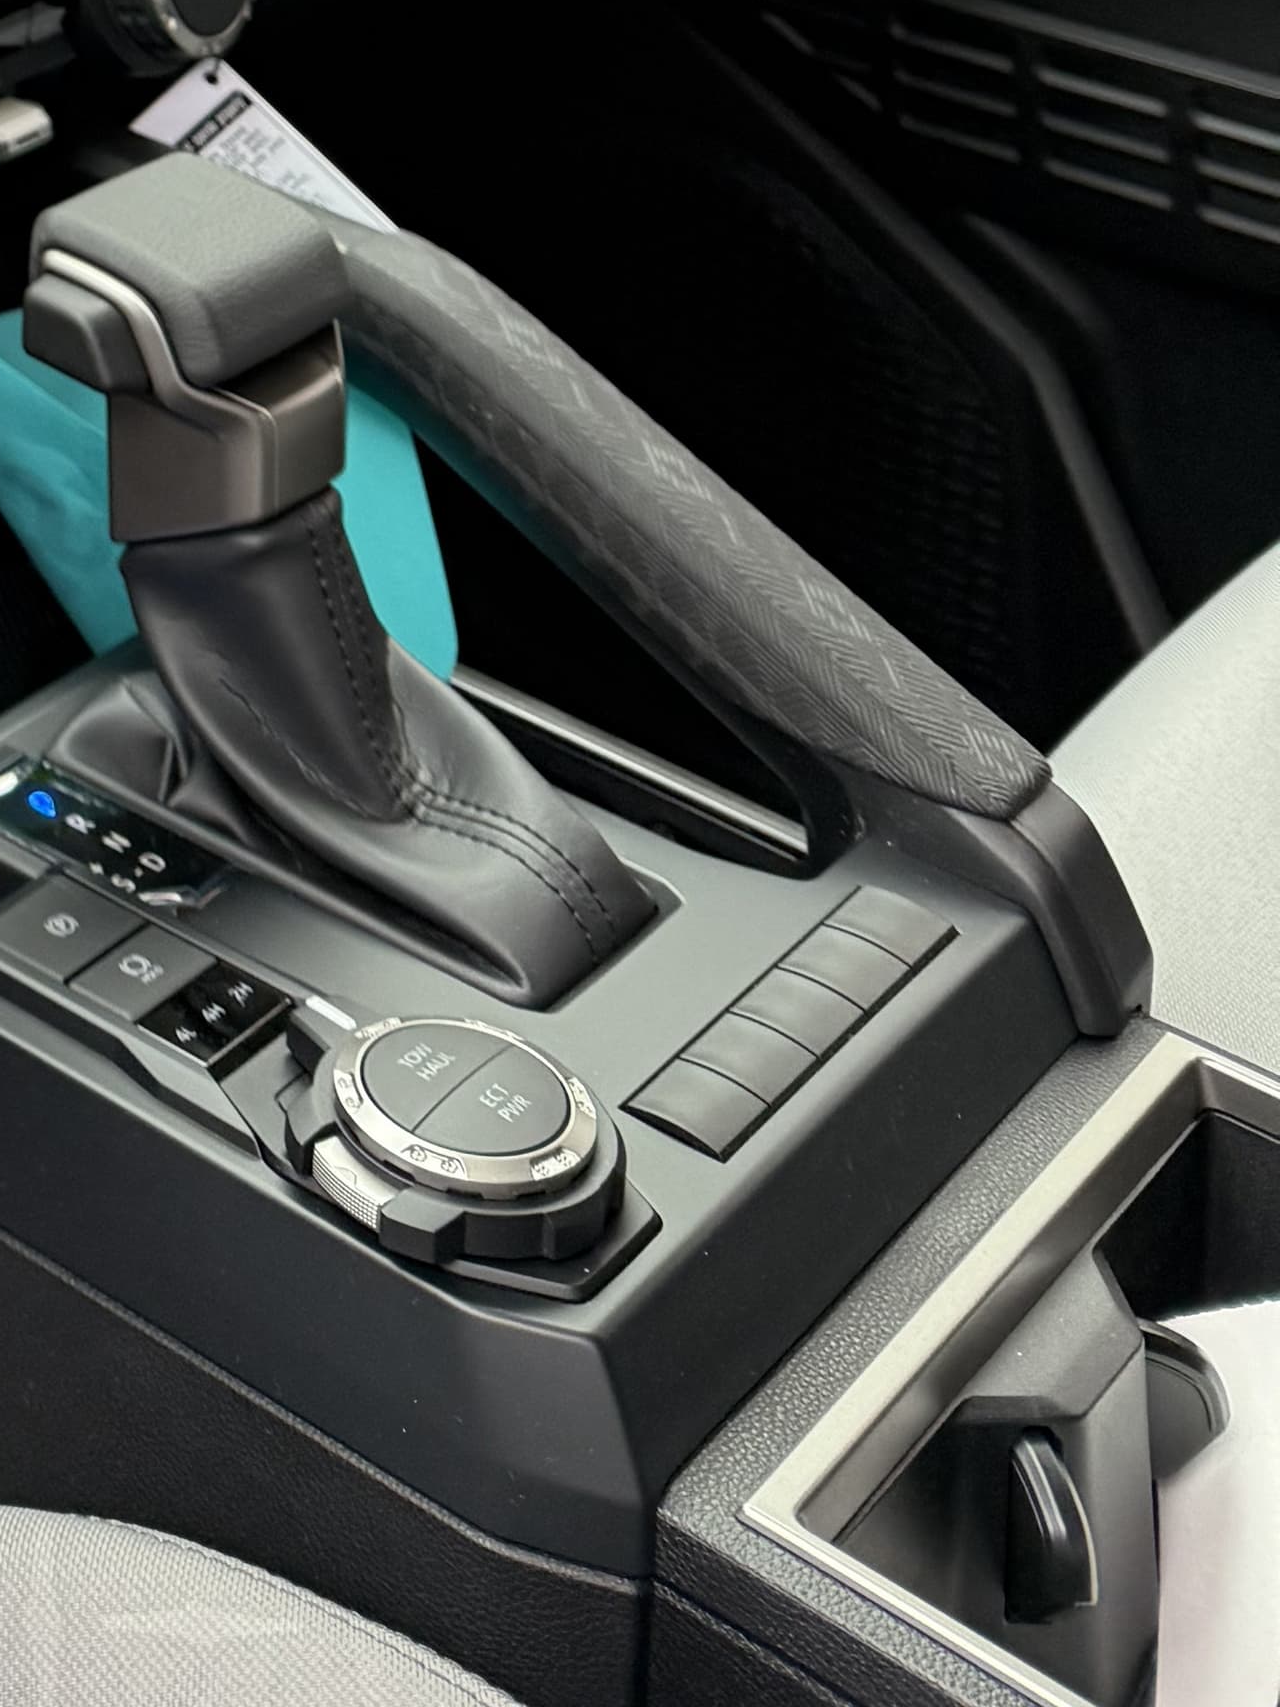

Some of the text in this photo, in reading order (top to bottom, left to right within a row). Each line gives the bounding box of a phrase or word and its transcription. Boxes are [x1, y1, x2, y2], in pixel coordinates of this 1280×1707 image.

[139, 851, 167, 873] D
[110, 873, 137, 894] S
[397, 1042, 433, 1070] TOW
[416, 1051, 457, 1082] HAUL
[479, 1082, 509, 1109] ECT
[497, 1094, 533, 1124] PWR
